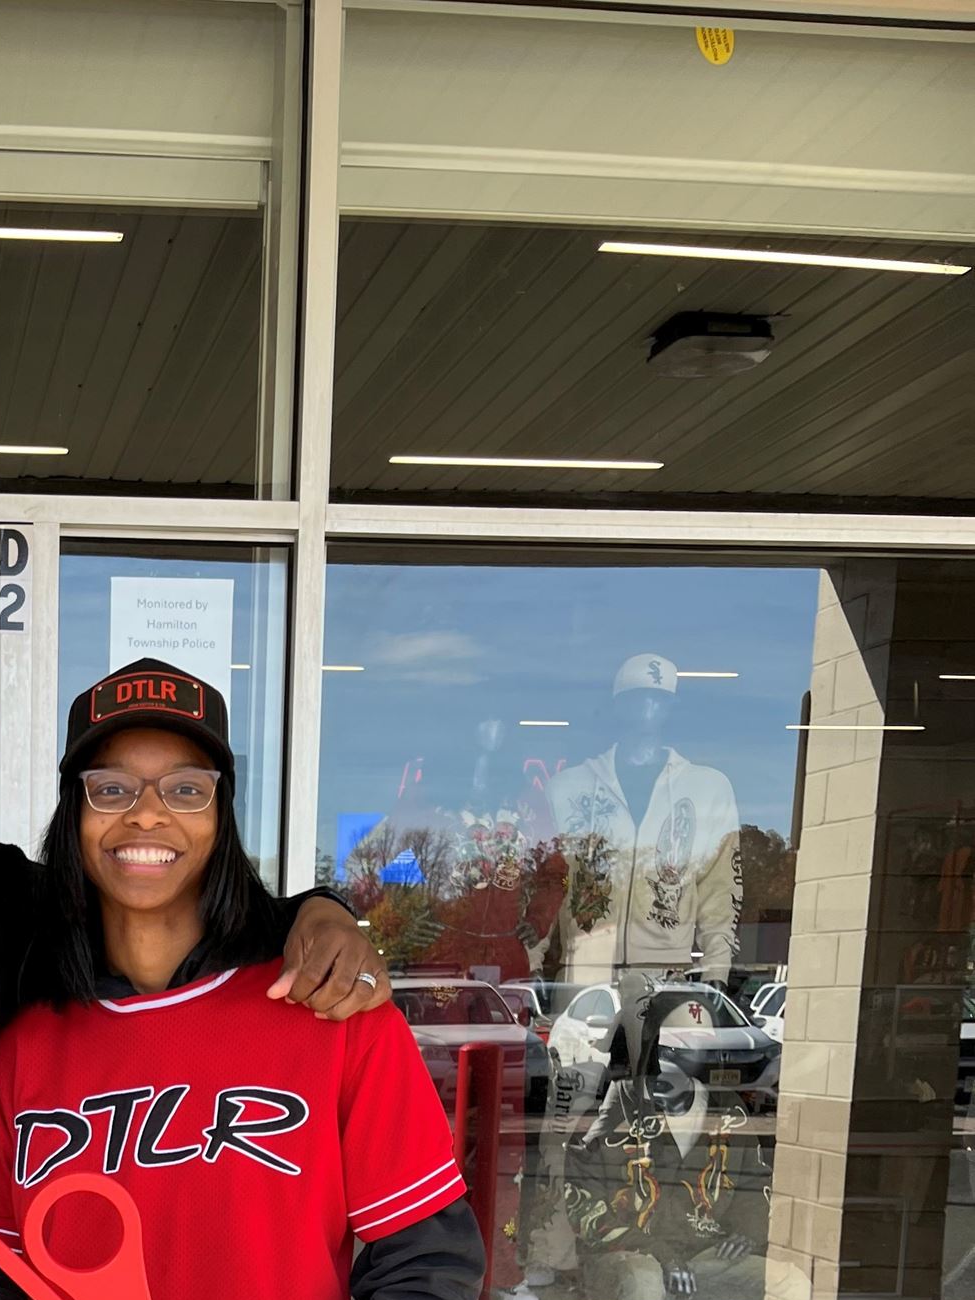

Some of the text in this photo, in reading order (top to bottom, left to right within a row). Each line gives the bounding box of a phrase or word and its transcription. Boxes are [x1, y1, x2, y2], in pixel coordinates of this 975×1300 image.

[136, 599, 209, 612] Monitored by
[146, 619, 198, 631] Hamilton
[127, 637, 216, 650] Township Police
[116, 678, 177, 704] DTLR
[14, 1084, 310, 1189] DTLR
